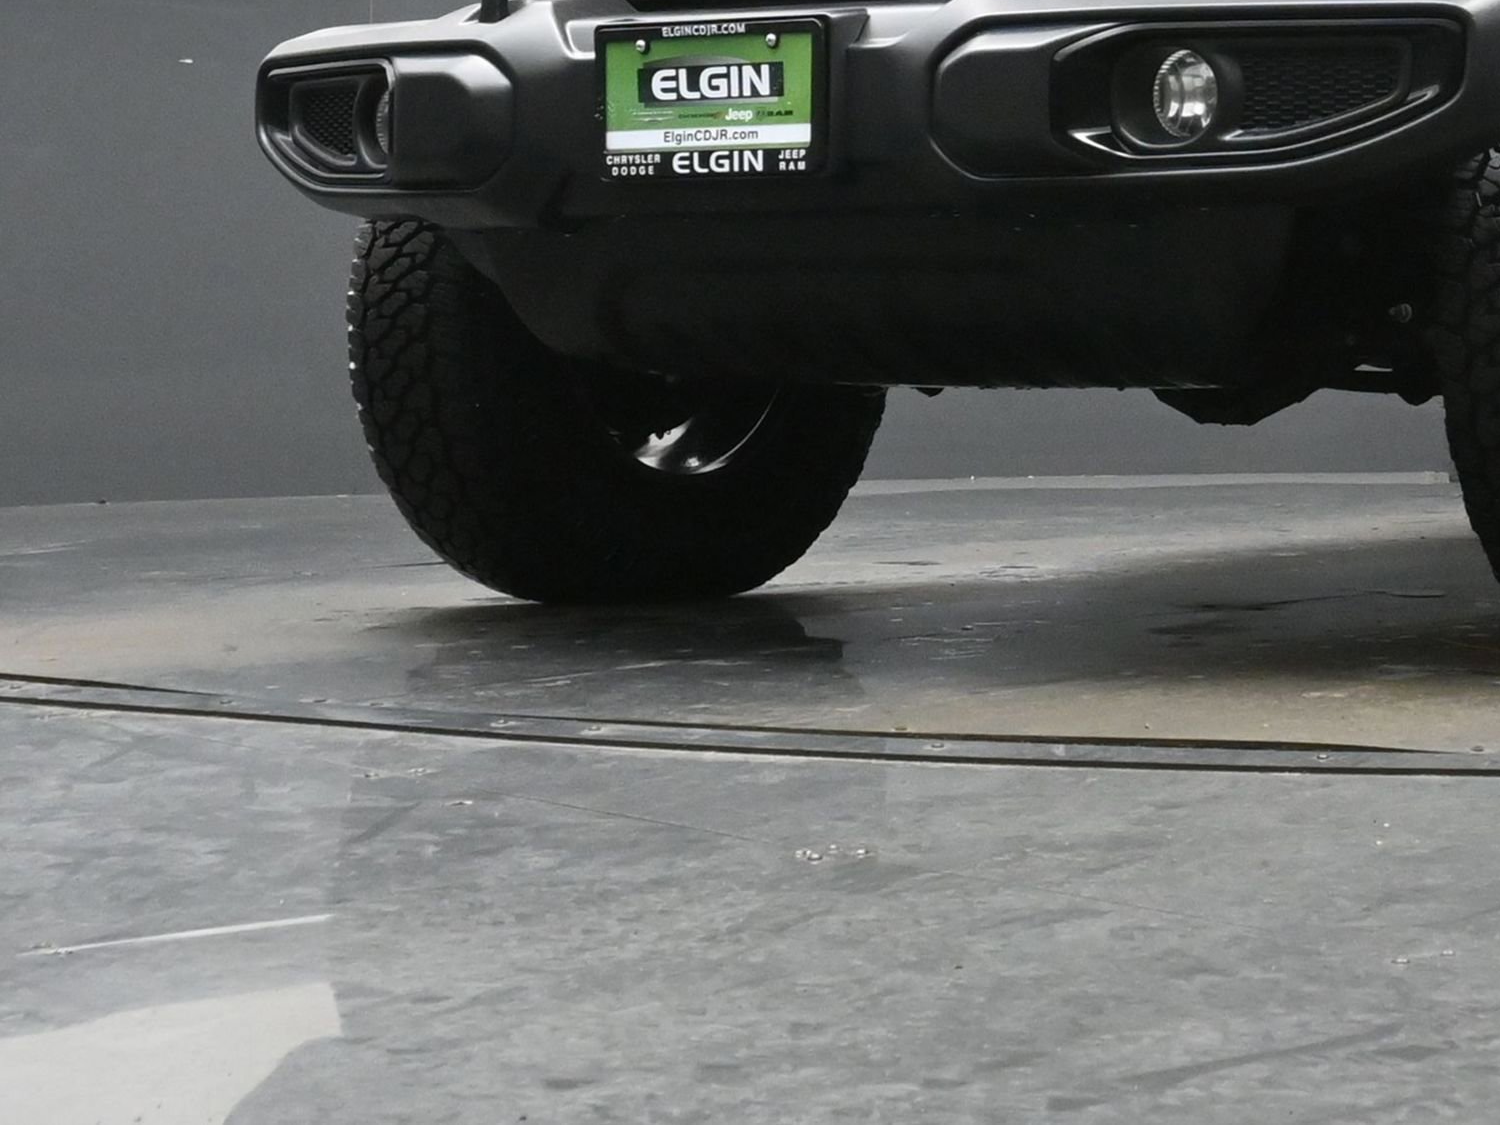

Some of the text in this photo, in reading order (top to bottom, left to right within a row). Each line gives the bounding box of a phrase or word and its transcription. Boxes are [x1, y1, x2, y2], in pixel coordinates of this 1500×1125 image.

[661, 23, 746, 38] ELGINCDJR.COM
[651, 64, 770, 101] ELGIN
[725, 108, 753, 122] Jeep
[663, 128, 759, 146] ElginCDJR.com
[606, 154, 661, 166] CHRYSLER
[672, 150, 764, 174] ELGIN
[778, 150, 806, 160] JEEP
[611, 166, 655, 176] DODGE
[779, 161, 806, 171] RAM
